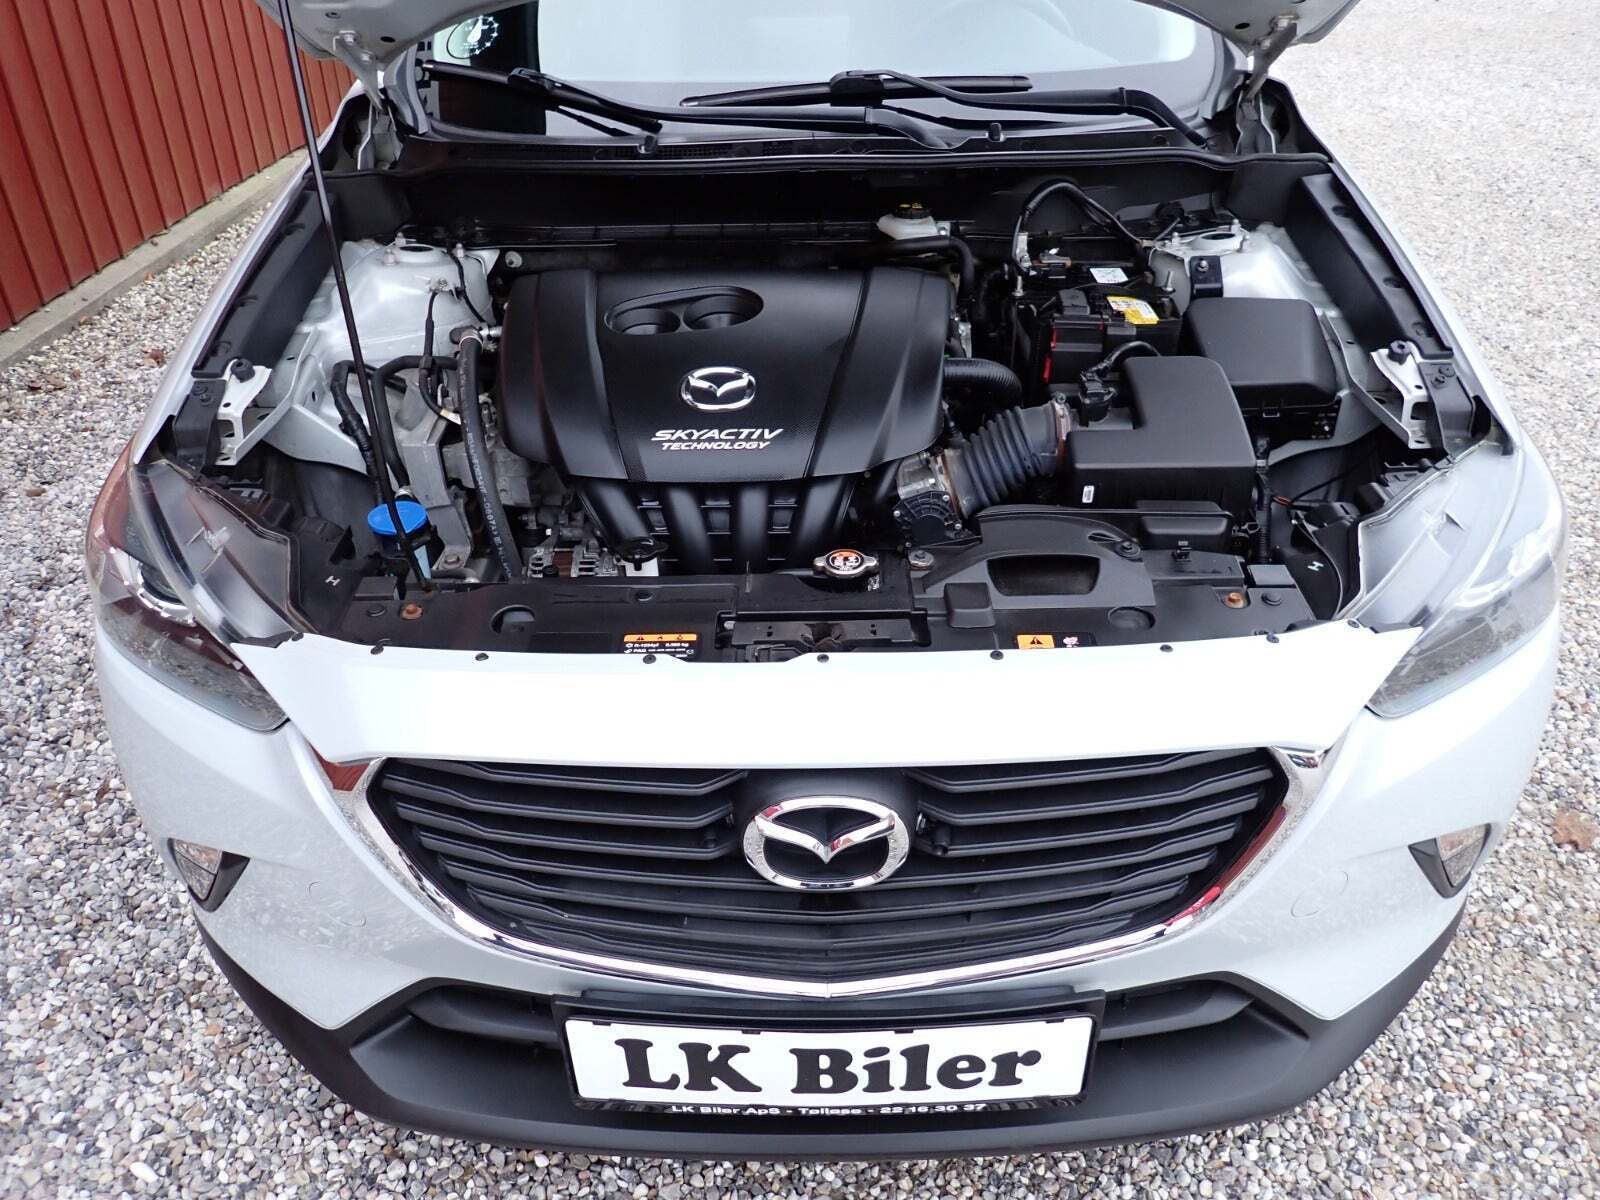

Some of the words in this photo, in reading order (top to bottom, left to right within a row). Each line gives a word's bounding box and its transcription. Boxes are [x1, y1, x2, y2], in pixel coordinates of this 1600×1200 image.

[650, 428, 784, 441] SKYACTIV
[661, 440, 771, 451] TECHNOLOGY
[614, 1038, 763, 1093] LK
[789, 1043, 1042, 1094] Biler
[671, 1105, 695, 1113] LK
[699, 1106, 741, 1115] Biler
[742, 1107, 781, 1116] ApS
[879, 1106, 904, 1114] 22
[907, 1105, 929, 1114] 16
[934, 1104, 958, 1112] 30
[963, 1103, 987, 1111] 37
